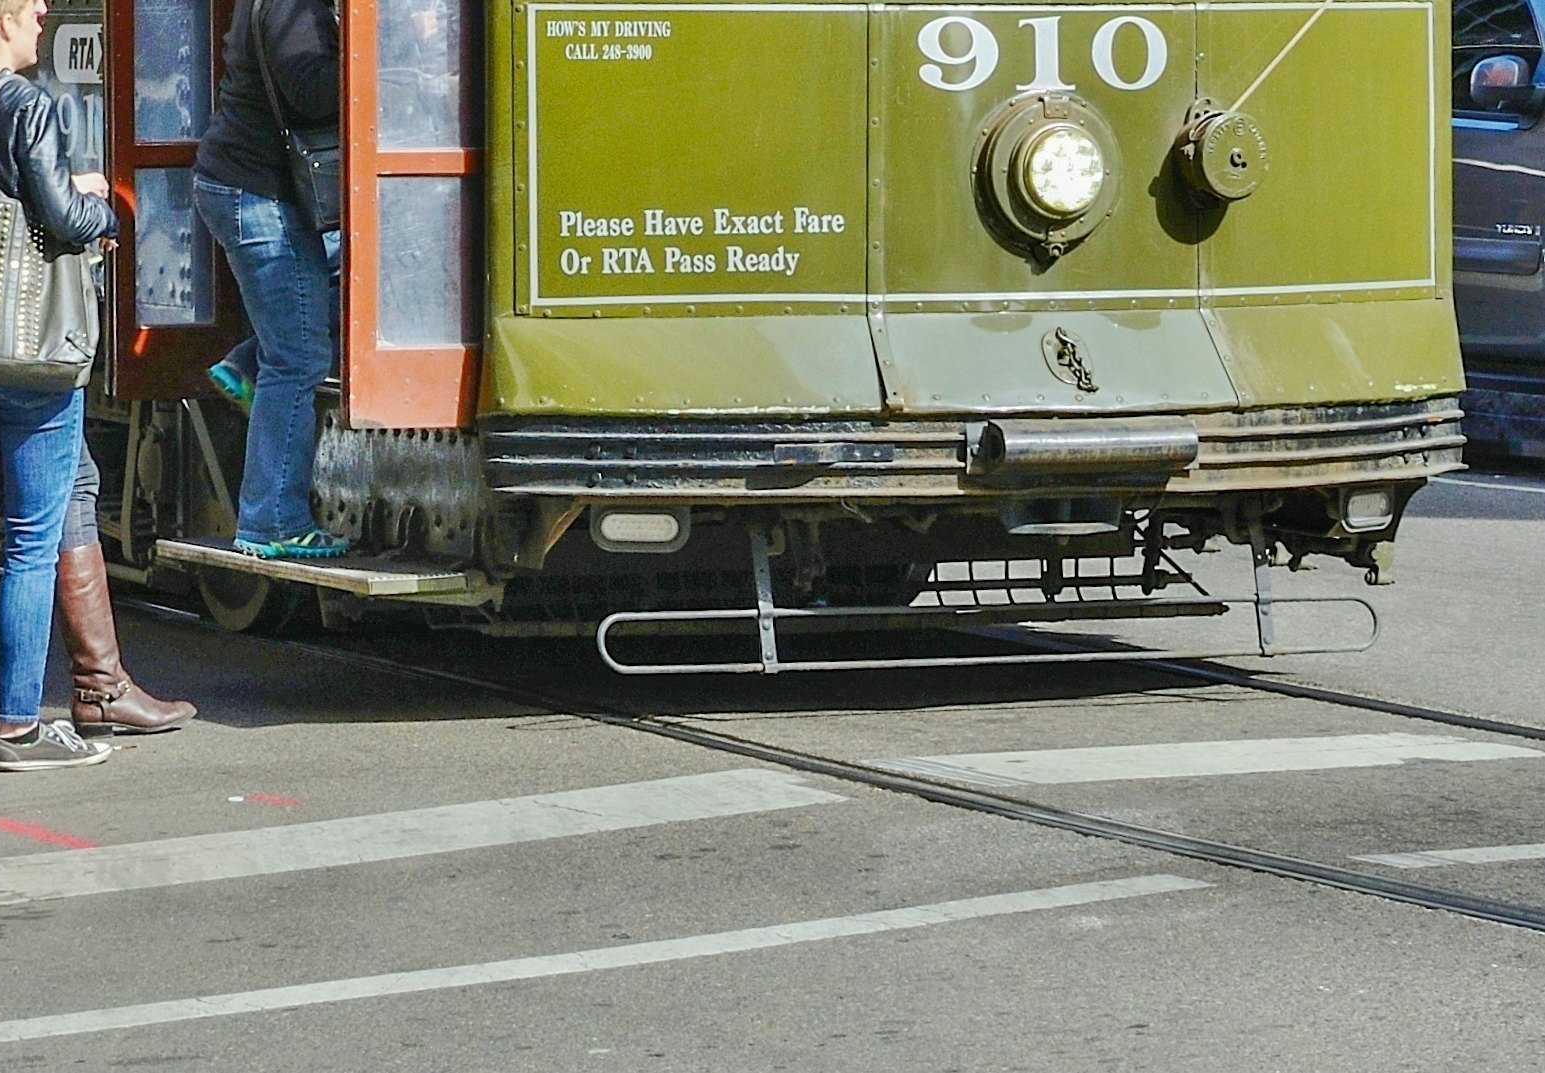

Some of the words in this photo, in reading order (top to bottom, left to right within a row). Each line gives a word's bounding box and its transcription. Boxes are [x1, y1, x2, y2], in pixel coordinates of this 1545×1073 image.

[546, 20, 586, 37] HOW'S
[590, 20, 611, 37] MY
[614, 20, 672, 37] DRIVING
[68, 36, 95, 70] RTA
[565, 43, 599, 60] CALL
[602, 43, 653, 60] 248-3900
[917, 15, 1168, 92] 910
[559, 210, 635, 238] Please
[643, 209, 705, 237] Have
[713, 208, 784, 235] Exact
[793, 206, 845, 234] Fare
[559, 247, 592, 276] Or
[601, 246, 655, 274] RTA
[663, 246, 717, 274] Pass
[725, 245, 801, 277] Ready
